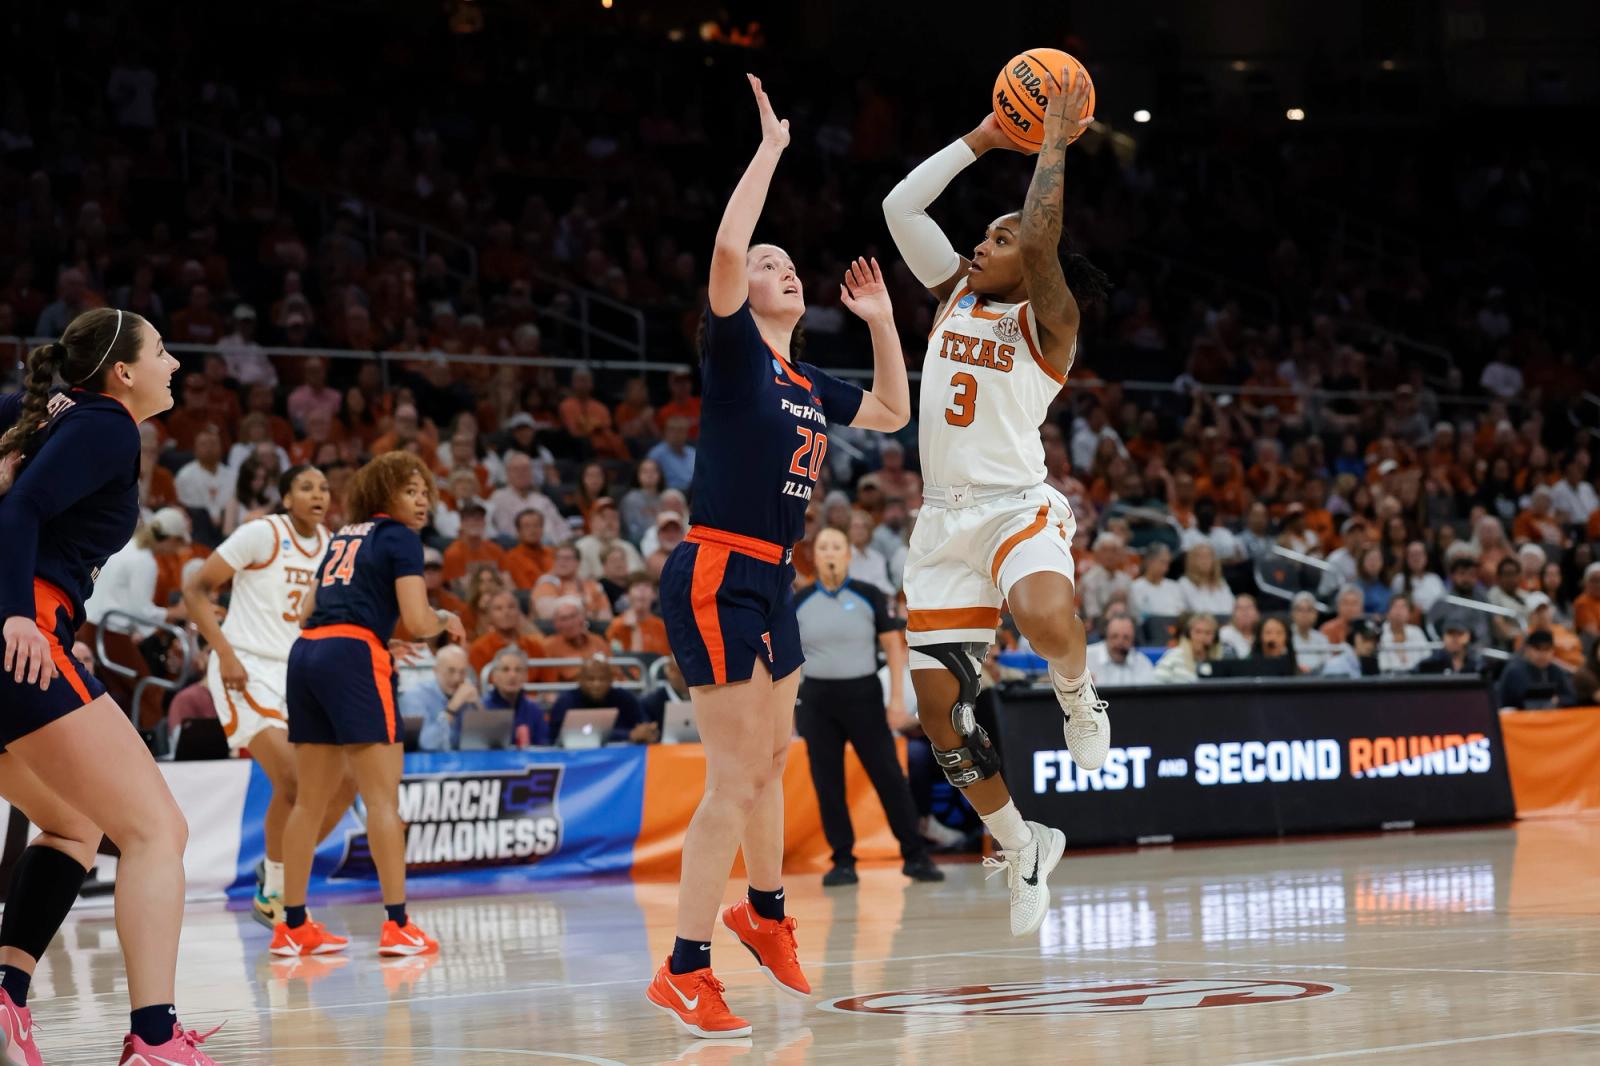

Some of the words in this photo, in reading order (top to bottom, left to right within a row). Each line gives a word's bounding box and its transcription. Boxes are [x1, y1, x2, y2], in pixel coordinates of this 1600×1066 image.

[1012, 60, 1048, 112] Wilso
[996, 89, 1032, 133] NCAA
[1000, 318, 1019, 337] SEC
[940, 330, 1016, 374] TEXAS
[944, 371, 978, 428] 3
[788, 425, 828, 482] 20
[782, 480, 812, 501] ILLIN
[284, 566, 314, 586] TEX
[321, 538, 362, 587] 24
[1194, 739, 1341, 785] SECOND
[1349, 733, 1491, 779] ROUNDS
[398, 779, 501, 823] MARCH
[404, 817, 557, 864] MADNESS
